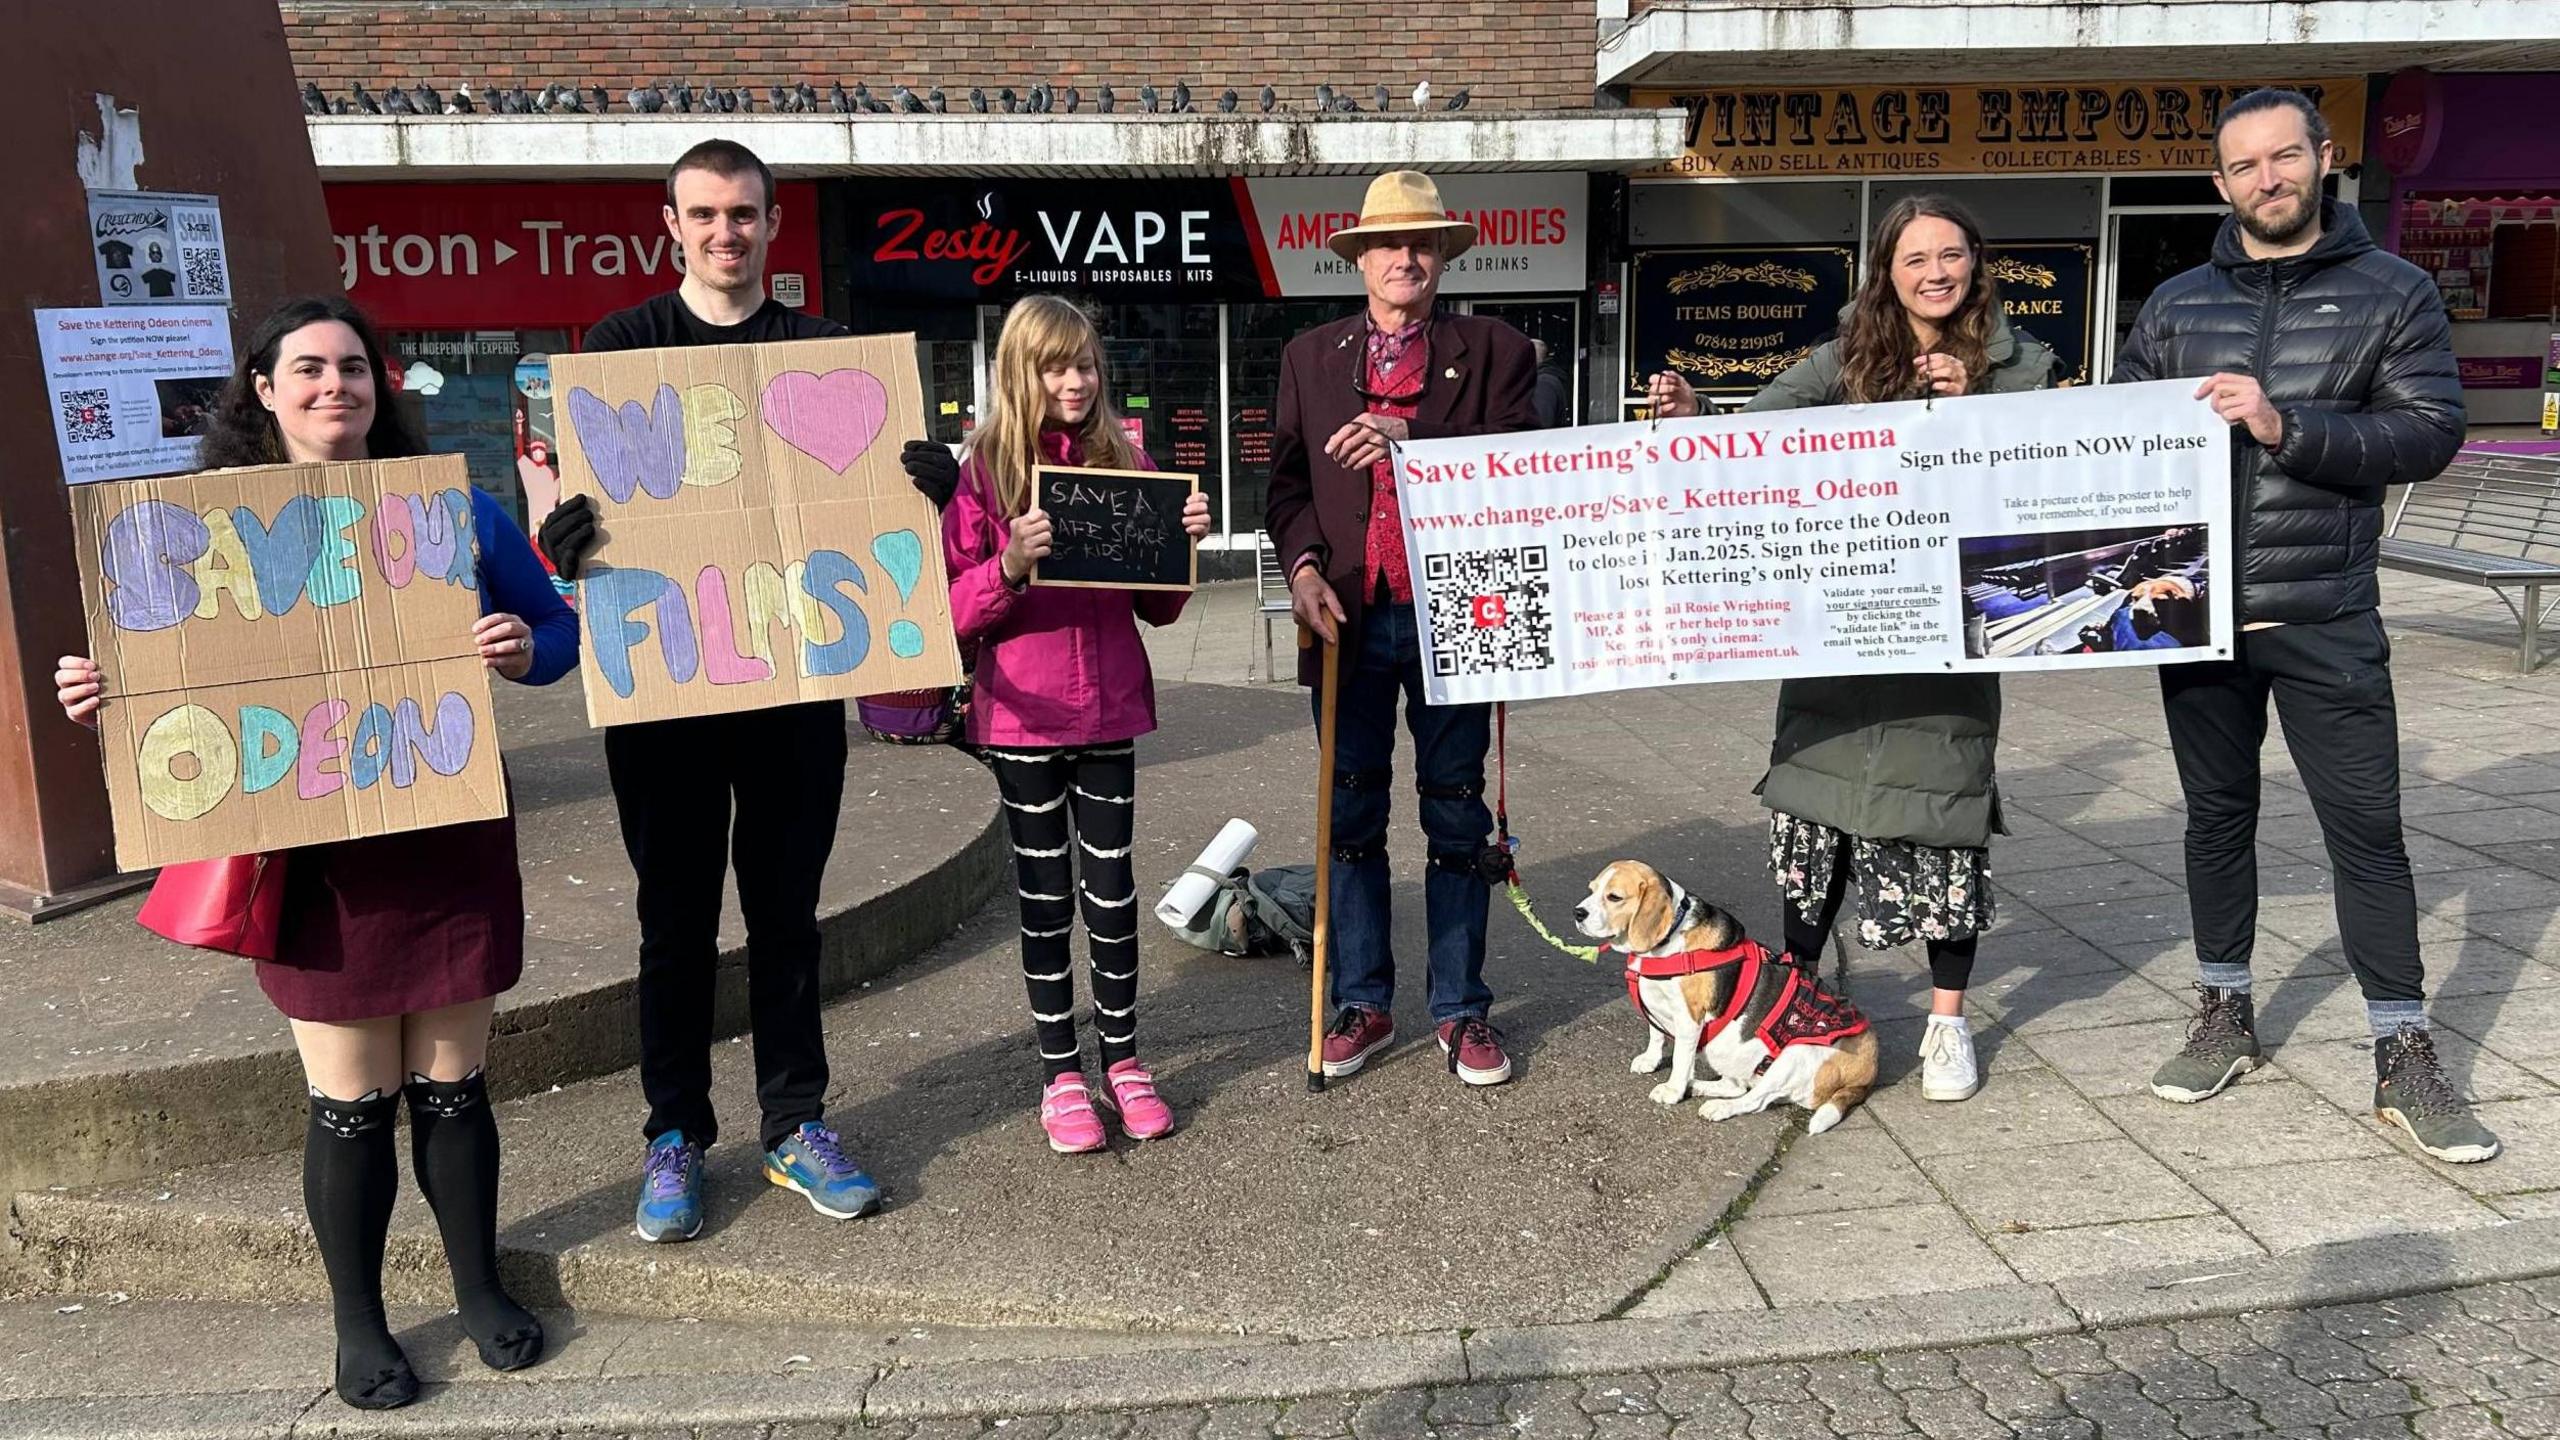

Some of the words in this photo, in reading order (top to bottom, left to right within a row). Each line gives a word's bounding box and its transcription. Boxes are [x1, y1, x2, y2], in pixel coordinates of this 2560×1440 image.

[1668, 88, 1950, 147] VINTAGE
[1976, 85, 2325, 143] EMPORI
[1682, 153, 1722, 172] BUY
[1731, 154, 1773, 171] AND
[1780, 153, 1829, 171] SELL
[1836, 152, 1940, 170] ANTIQUES
[1982, 148, 2141, 168] COLLECTABLES
[2160, 146, 2218, 165] VINT
[178, 211, 219, 242] SCAN
[187, 222, 210, 232] ME
[1445, 207, 1567, 247] NDIES
[873, 208, 1031, 286] Zesty
[1037, 210, 1211, 264] VAPE
[1459, 258, 1468, 272] &
[1476, 256, 1529, 271] DRINKS
[1015, 269, 1077, 283] E-LIQUIDS
[1092, 269, 1173, 283] DISPOSABLES
[1186, 268, 1214, 282] KITS
[1676, 305, 1731, 320] ITEMS
[1737, 304, 1807, 320] BOUGHT
[58, 320, 82, 331] Save
[84, 319, 101, 329] the
[102, 318, 146, 332] Kettering
[147, 317, 180, 329] Odeon
[181, 316, 213, 328] cinema
[90, 336, 106, 346] Sign
[107, 335, 119, 345] the
[146, 334, 165, 344] NOW
[166, 333, 191, 344] please!
[401, 342, 418, 355] THE
[419, 342, 479, 355] INDEPENDENT
[481, 341, 520, 354] EXPERTS
[1695, 333, 1737, 350] 07842
[1740, 331, 1784, 349] 219137
[568, 382, 748, 504] WE
[1899, 451, 1944, 472] Sign
[1951, 448, 1983, 465] the
[1989, 442, 2068, 468] petition
[2075, 435, 2136, 457] NOW
[2142, 434, 2207, 456] please
[1405, 459, 1475, 485] Save
[1485, 440, 1660, 480] Kettering's
[1669, 431, 1771, 463] ONLY
[1781, 427, 1897, 455] cinema
[1050, 481, 1128, 516] SAVE
[1133, 488, 1155, 517] A
[1410, 478, 1898, 532] www.change.org/Save_Kettering_Odeon
[2003, 498, 2029, 508] Take
[2041, 496, 2079, 508] picture
[2081, 493, 2095, 503] of
[2096, 492, 2115, 502] this
[2118, 492, 2151, 505] poster
[2154, 490, 2165, 499] to
[2168, 486, 2192, 500] help
[2016, 513, 2037, 523] you
[2039, 507, 2098, 519] remember,
[2101, 505, 2109, 515] if
[2111, 506, 2132, 518] you
[2135, 503, 2160, 514] need
[2163, 501, 2178, 512] to!
[1051, 518, 1103, 540] AFE
[1671, 526, 1701, 539] are
[1707, 520, 1765, 542] trying
[1771, 519, 1789, 534] to
[1796, 517, 1844, 533] force
[1850, 513, 1880, 529] the
[1886, 510, 1950, 527] Odeon
[102, 494, 365, 632] SAVE
[371, 487, 478, 590] OUR
[1568, 559, 1586, 572] to
[1592, 553, 1637, 569] close
[1666, 543, 1756, 563] Jan.2025.
[1761, 541, 1803, 561] Sign
[1810, 539, 1840, 555] the
[1846, 534, 1920, 557] petition
[1927, 535, 1948, 548] or
[1619, 574, 1649, 590] los
[1661, 565, 1767, 587] Kettering's
[1773, 563, 1813, 584] only
[1820, 558, 1897, 578] cinema!
[1823, 586, 1865, 598] Validate
[1871, 587, 1895, 598] your
[1898, 583, 1929, 594] email,
[1931, 584, 1943, 594] so
[584, 528, 924, 698] FILMS!
[1645, 603, 1681, 617] eail
[1685, 602, 1721, 614] Rosie
[1722, 599, 1791, 613] Wrighting
[1826, 602, 1850, 612] your
[1853, 598, 1901, 611] signature
[1847, 612, 1859, 623] by
[1862, 610, 1903, 621] clicking
[1905, 609, 1922, 618] the
[1585, 626, 1612, 637] MP,
[1615, 624, 1625, 636] &
[1680, 617, 1701, 629] her
[1705, 615, 1732, 629] help
[1736, 615, 1748, 627] to
[1757, 616, 1781, 627] save
[1830, 623, 1878, 634] "validate
[1910, 621, 1920, 630] in
[1923, 620, 1940, 629] the
[1681, 634, 1707, 647] only
[1712, 632, 1763, 645] cinema:
[1823, 636, 1851, 647] email
[1854, 635, 1885, 645] which
[1888, 633, 1948, 644] Change.org
[1857, 648, 1885, 657] sends
[139, 691, 475, 821] ODEON
